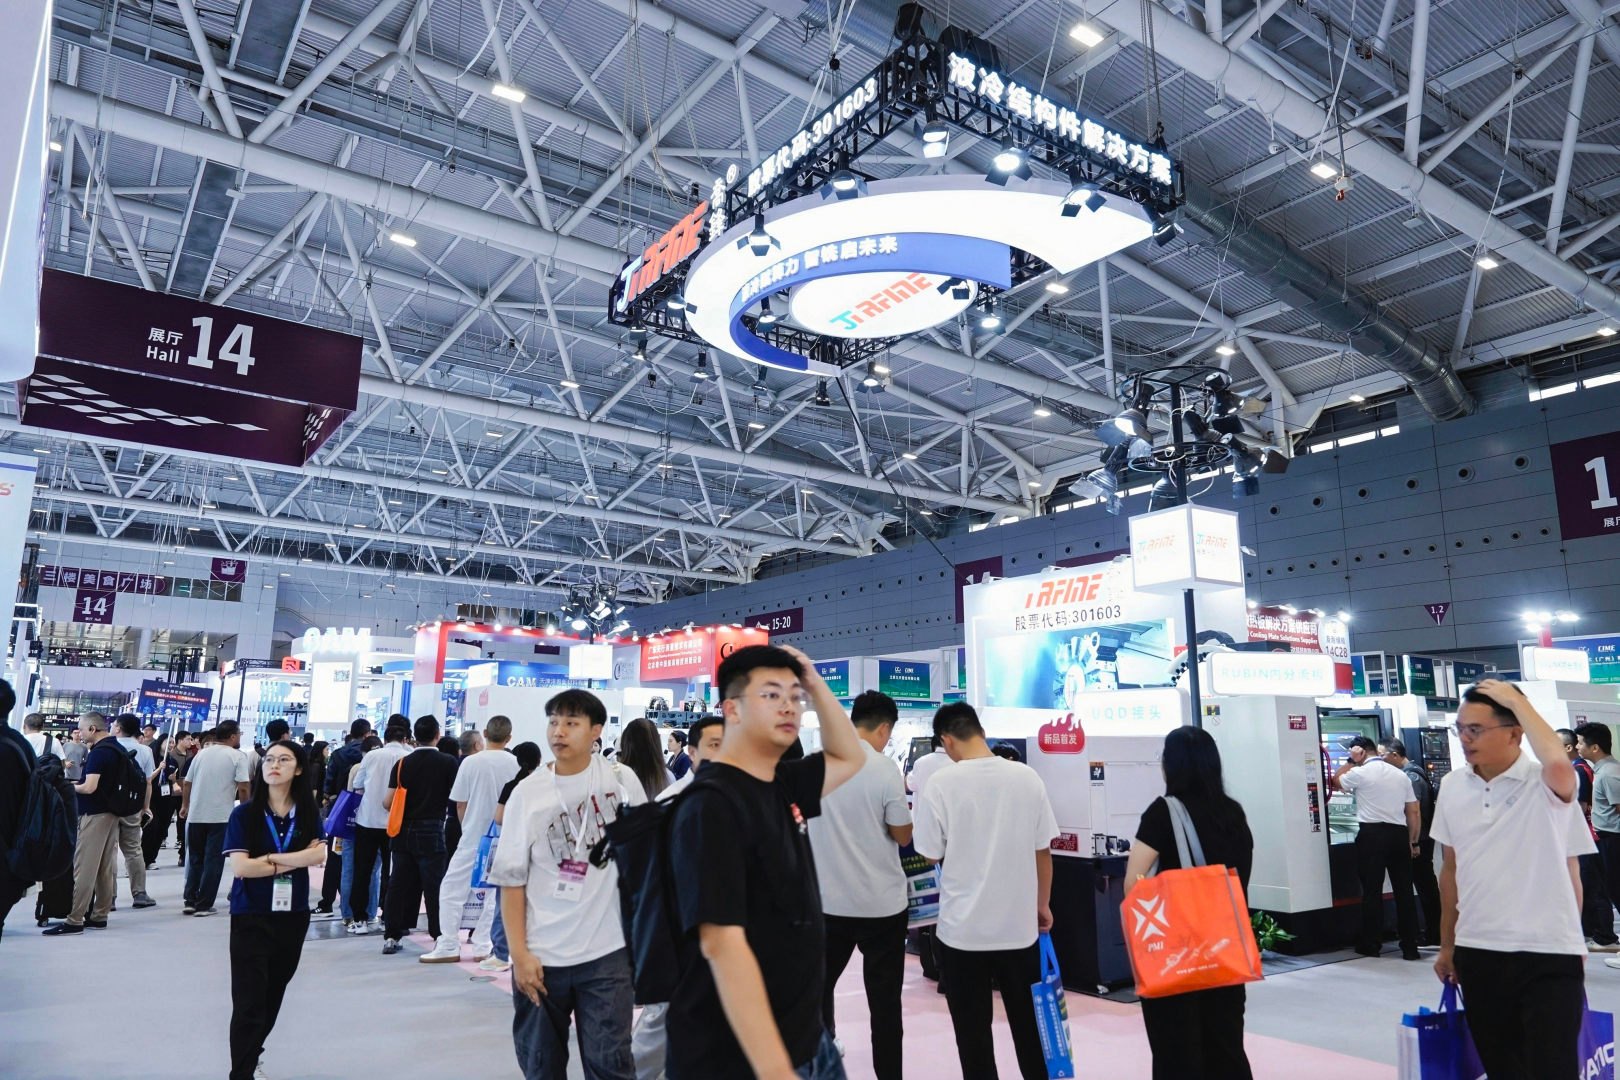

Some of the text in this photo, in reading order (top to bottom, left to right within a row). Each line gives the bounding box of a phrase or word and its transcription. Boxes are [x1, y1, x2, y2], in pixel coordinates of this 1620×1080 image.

[148, 327, 184, 346] 展厅
[146, 345, 180, 364] Hall
[187, 316, 256, 376] 14
[43, 570, 152, 590] 三楼美食广场
[82, 596, 107, 616] 14
[772, 615, 791, 630] 15-20
[1015, 604, 1121, 631] 股票代码:301603
[1250, 630, 1268, 641] Cooling
[1268, 632, 1280, 640] Plate
[1280, 633, 1300, 643] Solutions
[1300, 635, 1318, 646] Supplier
[1325, 645, 1348, 658] 14C28
[506, 676, 537, 688] CAM
[1044, 733, 1077, 745] 新品首发
[1147, 941, 1164, 952] PMI
